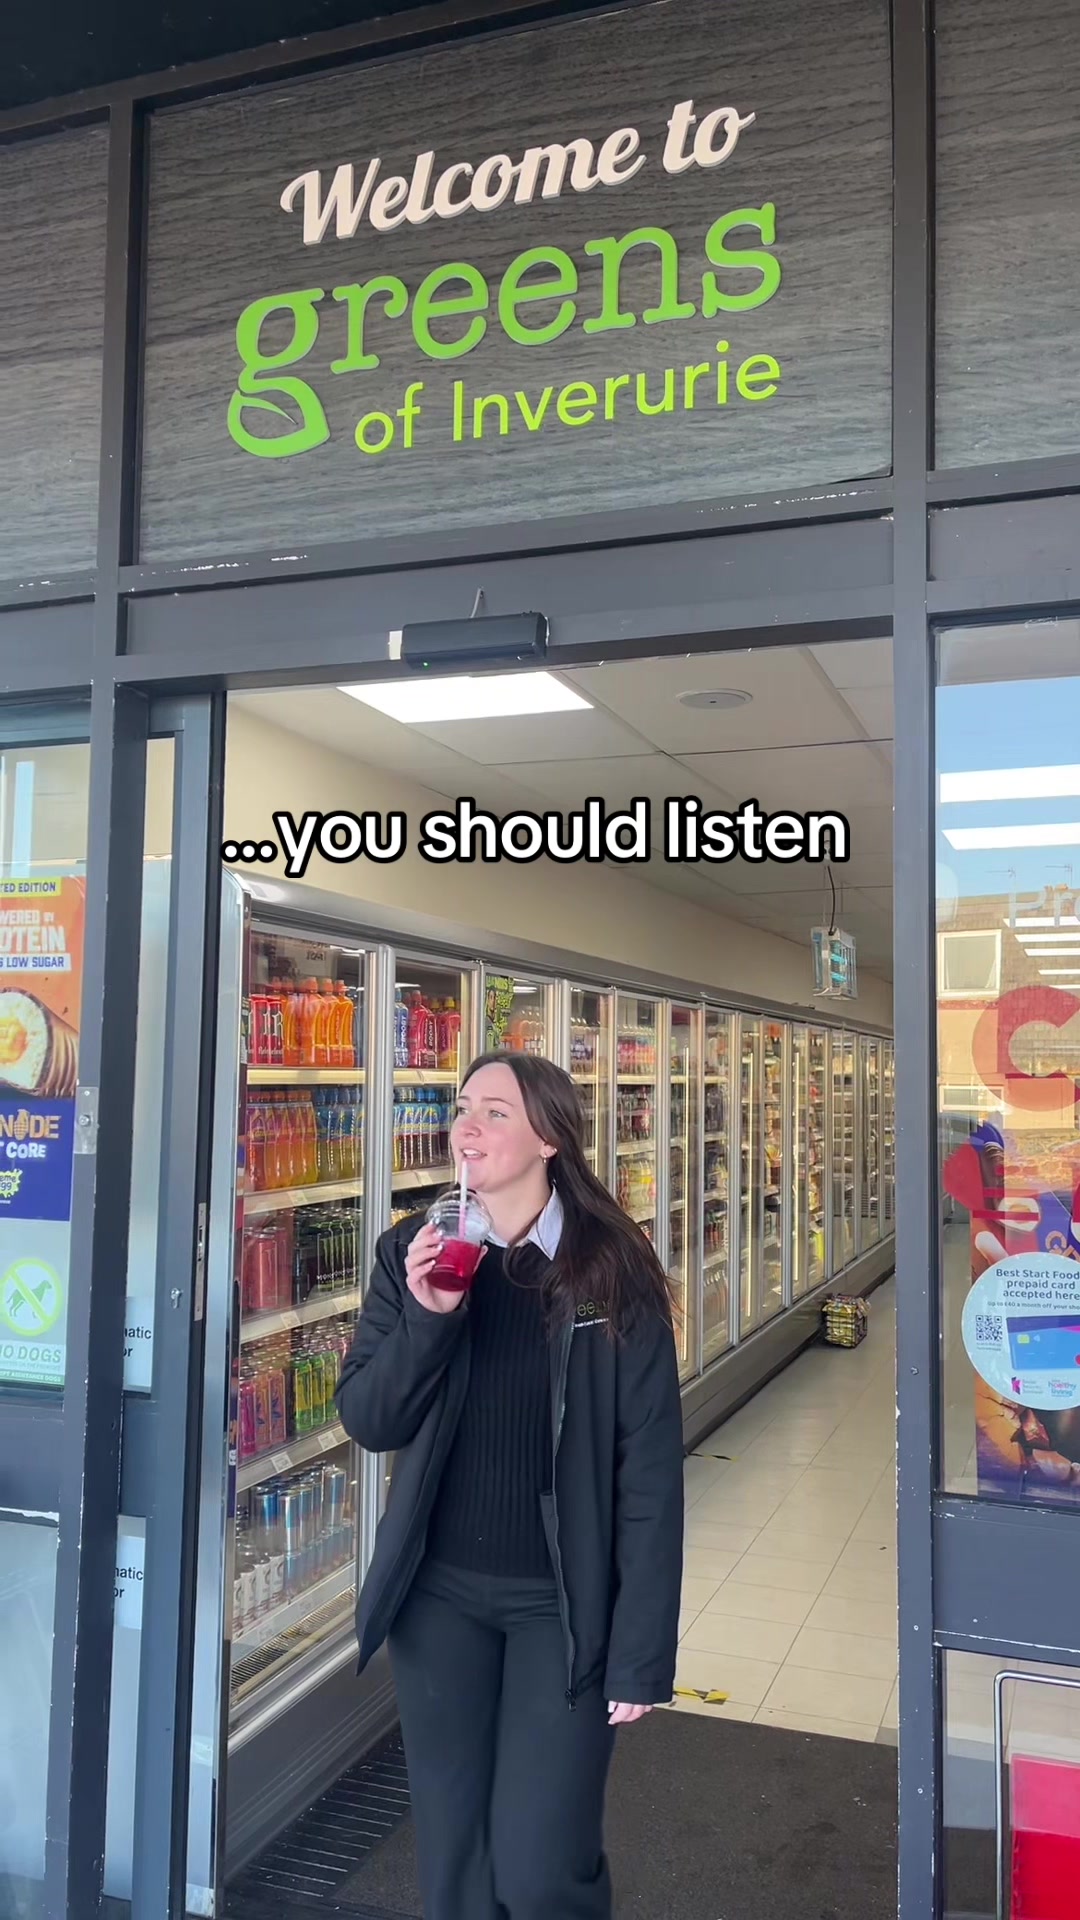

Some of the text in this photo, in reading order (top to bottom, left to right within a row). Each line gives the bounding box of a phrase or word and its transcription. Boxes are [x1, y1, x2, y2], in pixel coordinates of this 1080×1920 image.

[280, 99, 756, 246] Welcome to
[226, 202, 782, 458] greens
[354, 339, 781, 454] of Inverurie
[18, 881, 56, 892] EDITION
[6, 956, 65, 967] LOW SUGAR
[996, 1268, 1020, 1277] Best
[1022, 1269, 1050, 1279] Start
[1007, 1280, 1076, 1290] prepaid card
[1003, 1290, 1080, 1300] accepted here
[18, 1346, 61, 1363] DOGS
